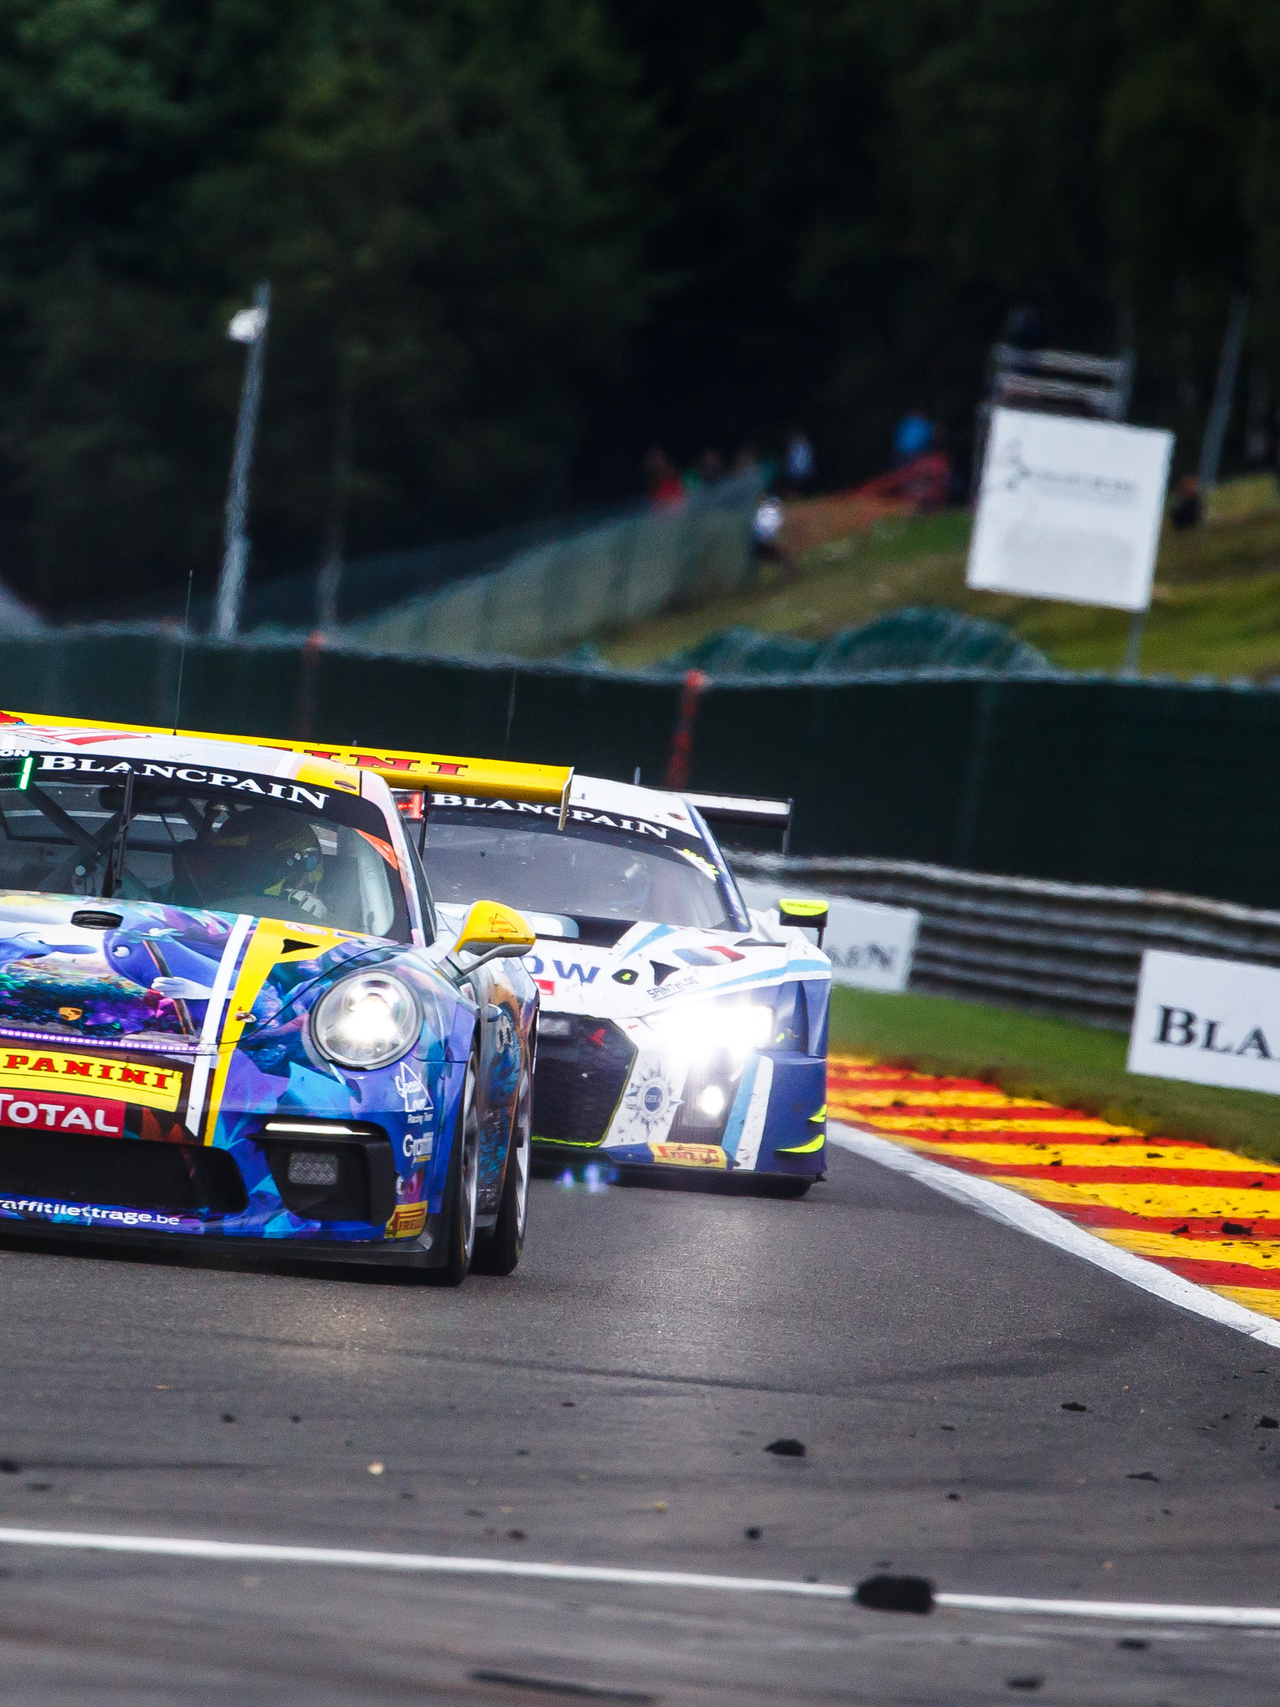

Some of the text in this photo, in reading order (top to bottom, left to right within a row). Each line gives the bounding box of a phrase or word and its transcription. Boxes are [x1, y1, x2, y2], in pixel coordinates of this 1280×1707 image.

[36, 754, 331, 810] BLANCPAIN
[430, 792, 670, 840] BLANCPAIN
[3, 1053, 169, 1090] PANINI
